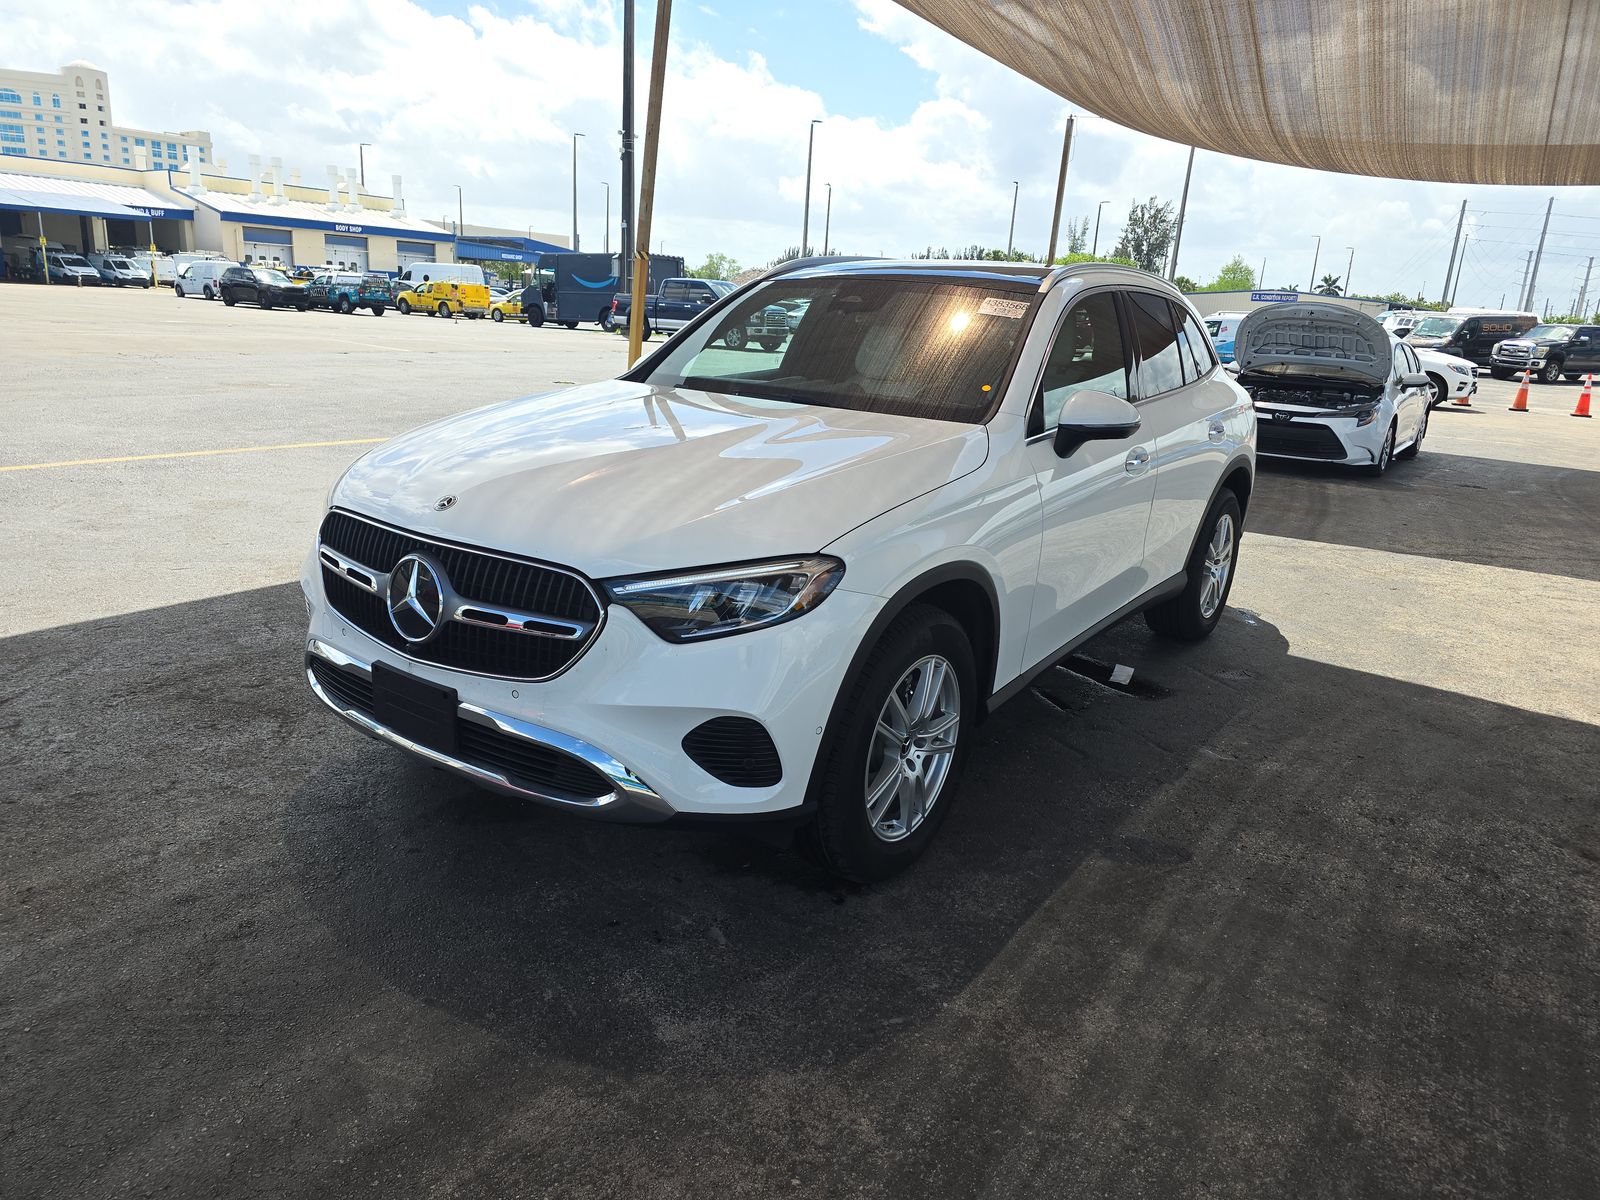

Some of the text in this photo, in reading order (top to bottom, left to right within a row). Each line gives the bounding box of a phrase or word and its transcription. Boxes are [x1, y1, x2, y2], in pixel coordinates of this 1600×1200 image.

[151, 209, 165, 217] BUFF
[335, 224, 363, 233] BODY SHOP
[1482, 323, 1512, 331] SOLID
